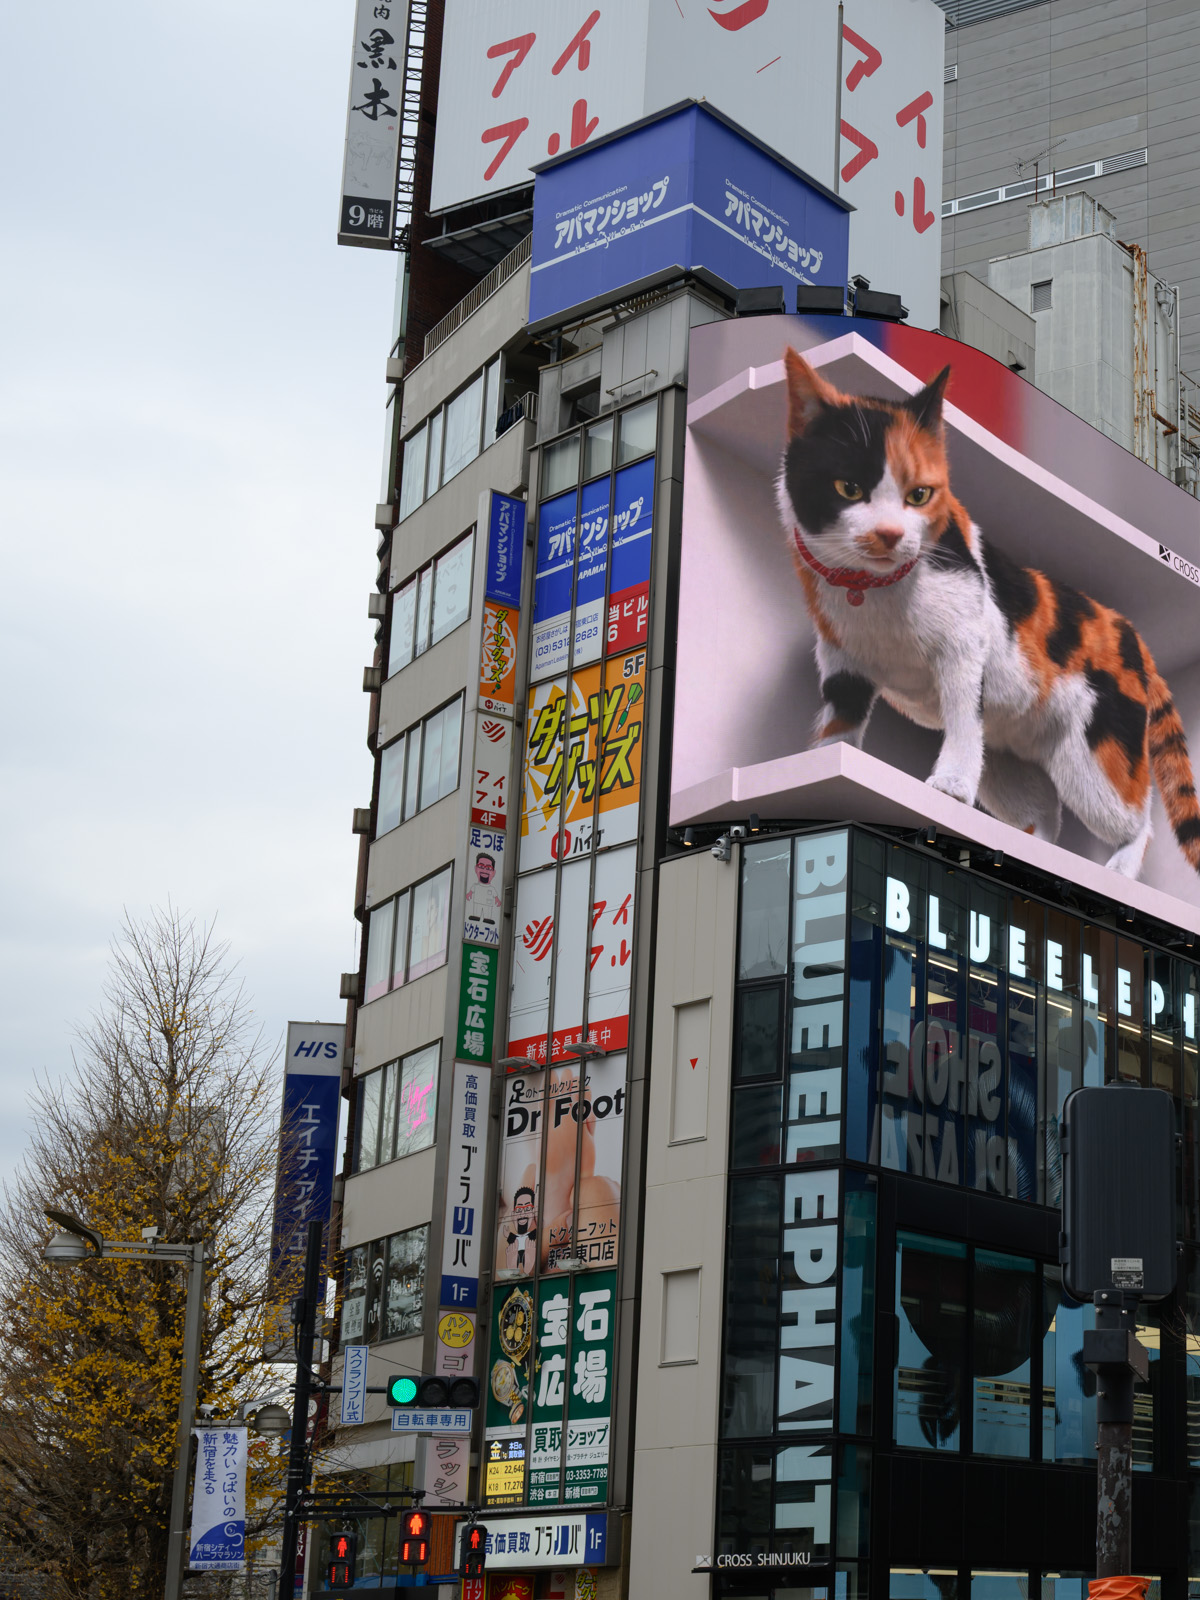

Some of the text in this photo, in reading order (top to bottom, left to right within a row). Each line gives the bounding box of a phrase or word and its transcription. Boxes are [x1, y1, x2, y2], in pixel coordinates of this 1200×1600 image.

[486, 10, 600, 98] アイ
[351, 28, 398, 121] 黒木
[554, 175, 670, 249] アパマンショップ
[555, 185, 628, 219] Dramatic Communication
[725, 178, 789, 226] Dramatic Communication
[724, 190, 823, 274] アパマンショップ
[496, 500, 510, 582] アパマンショップ
[1174, 556, 1199, 583] CROSS
[609, 595, 648, 623] 当ビル
[607, 613, 646, 642] 6 F
[490, 610, 508, 682] ダーツグッズ
[622, 652, 646, 679] 5F
[529, 684, 625, 766] ダーツ
[477, 769, 505, 789] アイ
[544, 721, 641, 808] グッズ
[475, 790, 505, 808] フル
[480, 813, 496, 826] 4F
[470, 829, 504, 851] 足つぼ
[592, 894, 631, 931] アイ
[464, 922, 499, 945] ドクターフット
[590, 939, 631, 972] フル
[463, 951, 490, 1056] 宝石広場
[509, 1076, 591, 1107] 足のトールクリニク
[507, 1088, 625, 1137] Dr Foot
[452, 1074, 478, 1267] 高価買取 ブラリバ
[452, 1283, 469, 1302] 1F
[540, 1289, 611, 1347] 宝石
[347, 1349, 362, 1421] スクランブル式
[537, 1349, 608, 1407] 広場
[398, 1414, 466, 1427] 自転車専用
[490, 1441, 502, 1460] 金
[533, 1424, 608, 1453] 買取ショップ
[203, 1432, 218, 1495] 新宿を走る
[222, 1431, 239, 1517] 魅力いっぱいの
[489, 1464, 524, 1475] K24 22,640
[544, 1455, 560, 1463] ダイヤモン
[488, 1480, 524, 1492] K18 17,270
[530, 1472, 546, 1484] 新宿
[566, 1467, 608, 1481] 03-3353-7789
[529, 1488, 545, 1501] 渋谷
[565, 1486, 580, 1500] 新橋
[196, 1543, 231, 1552] 新宿シティ
[484, 1524, 602, 1556] 高価買取 ブラリバ 1F
[195, 1551, 244, 1560] ハーフマラソン
[717, 1552, 811, 1567] CROSS SHINJUKU
[493, 1580, 531, 1595] ハンバーグ
